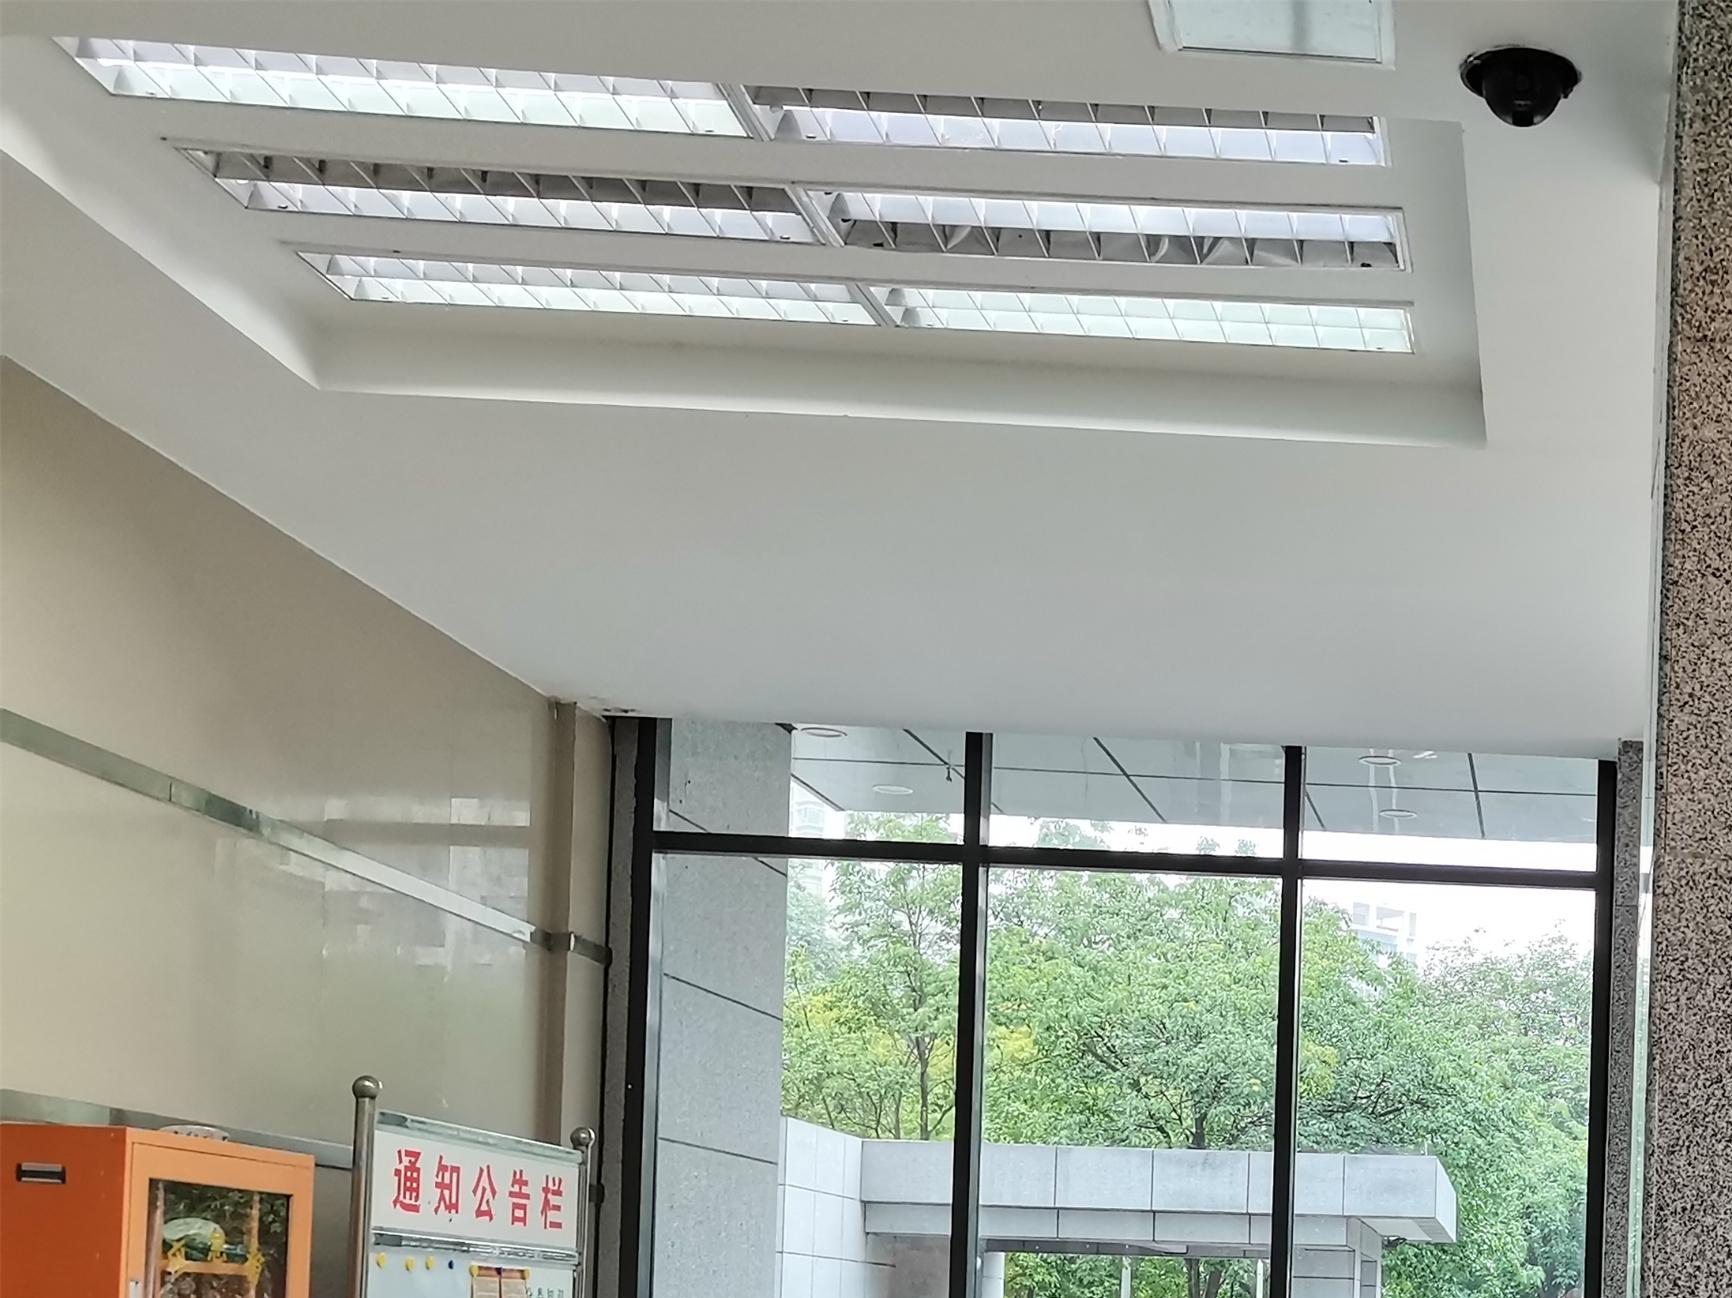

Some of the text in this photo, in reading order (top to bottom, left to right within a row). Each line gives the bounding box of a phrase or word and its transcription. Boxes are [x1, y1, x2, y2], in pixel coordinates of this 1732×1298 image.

[392, 1149, 563, 1230] 通知公告栏
